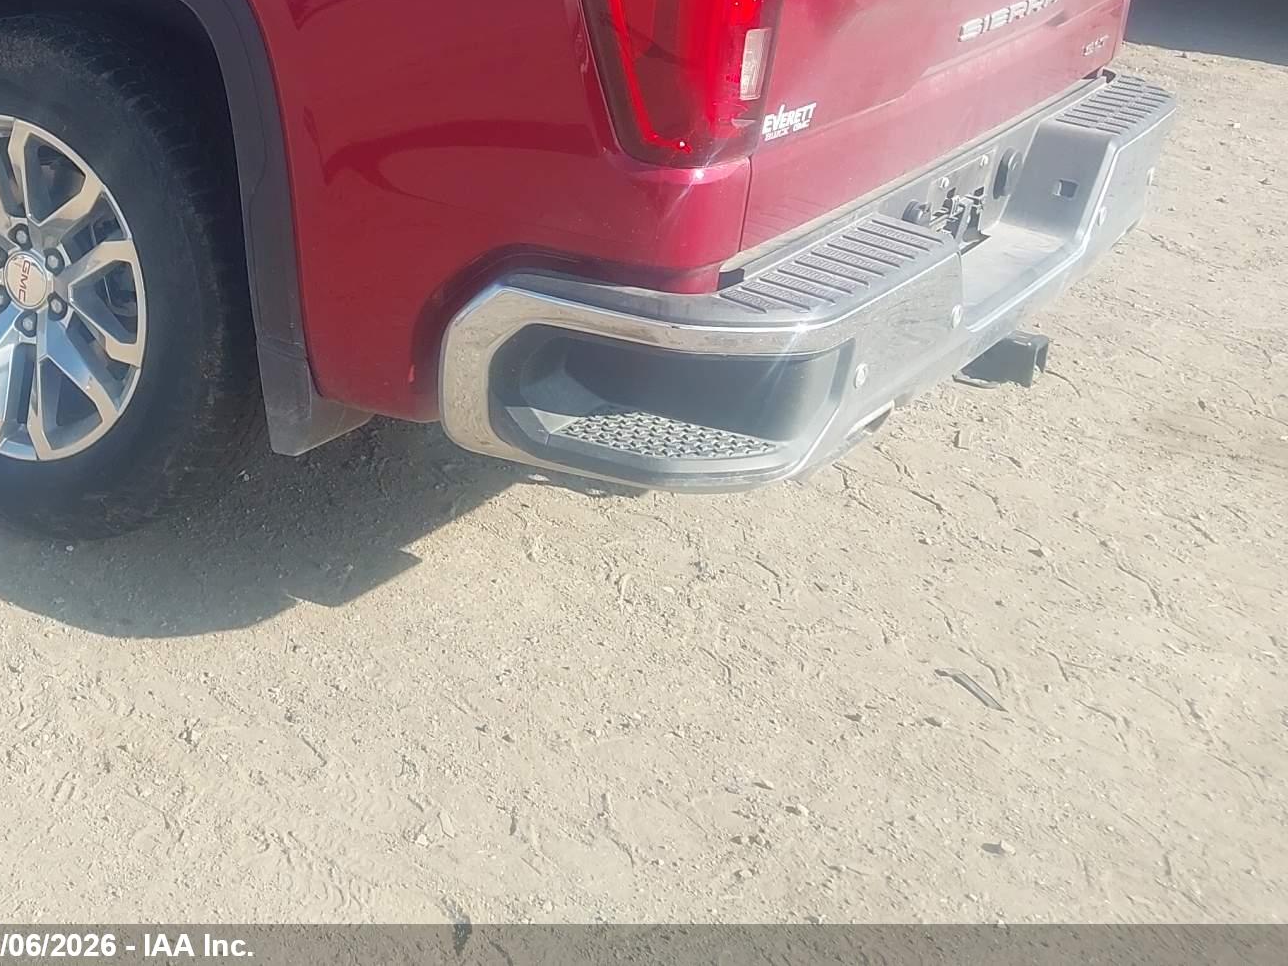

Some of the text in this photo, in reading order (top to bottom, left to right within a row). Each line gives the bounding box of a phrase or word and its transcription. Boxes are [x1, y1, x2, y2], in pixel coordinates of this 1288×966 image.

[762, 102, 817, 134] EVERETT
[764, 127, 789, 141] BUICK
[18, 259, 31, 304] GMC
